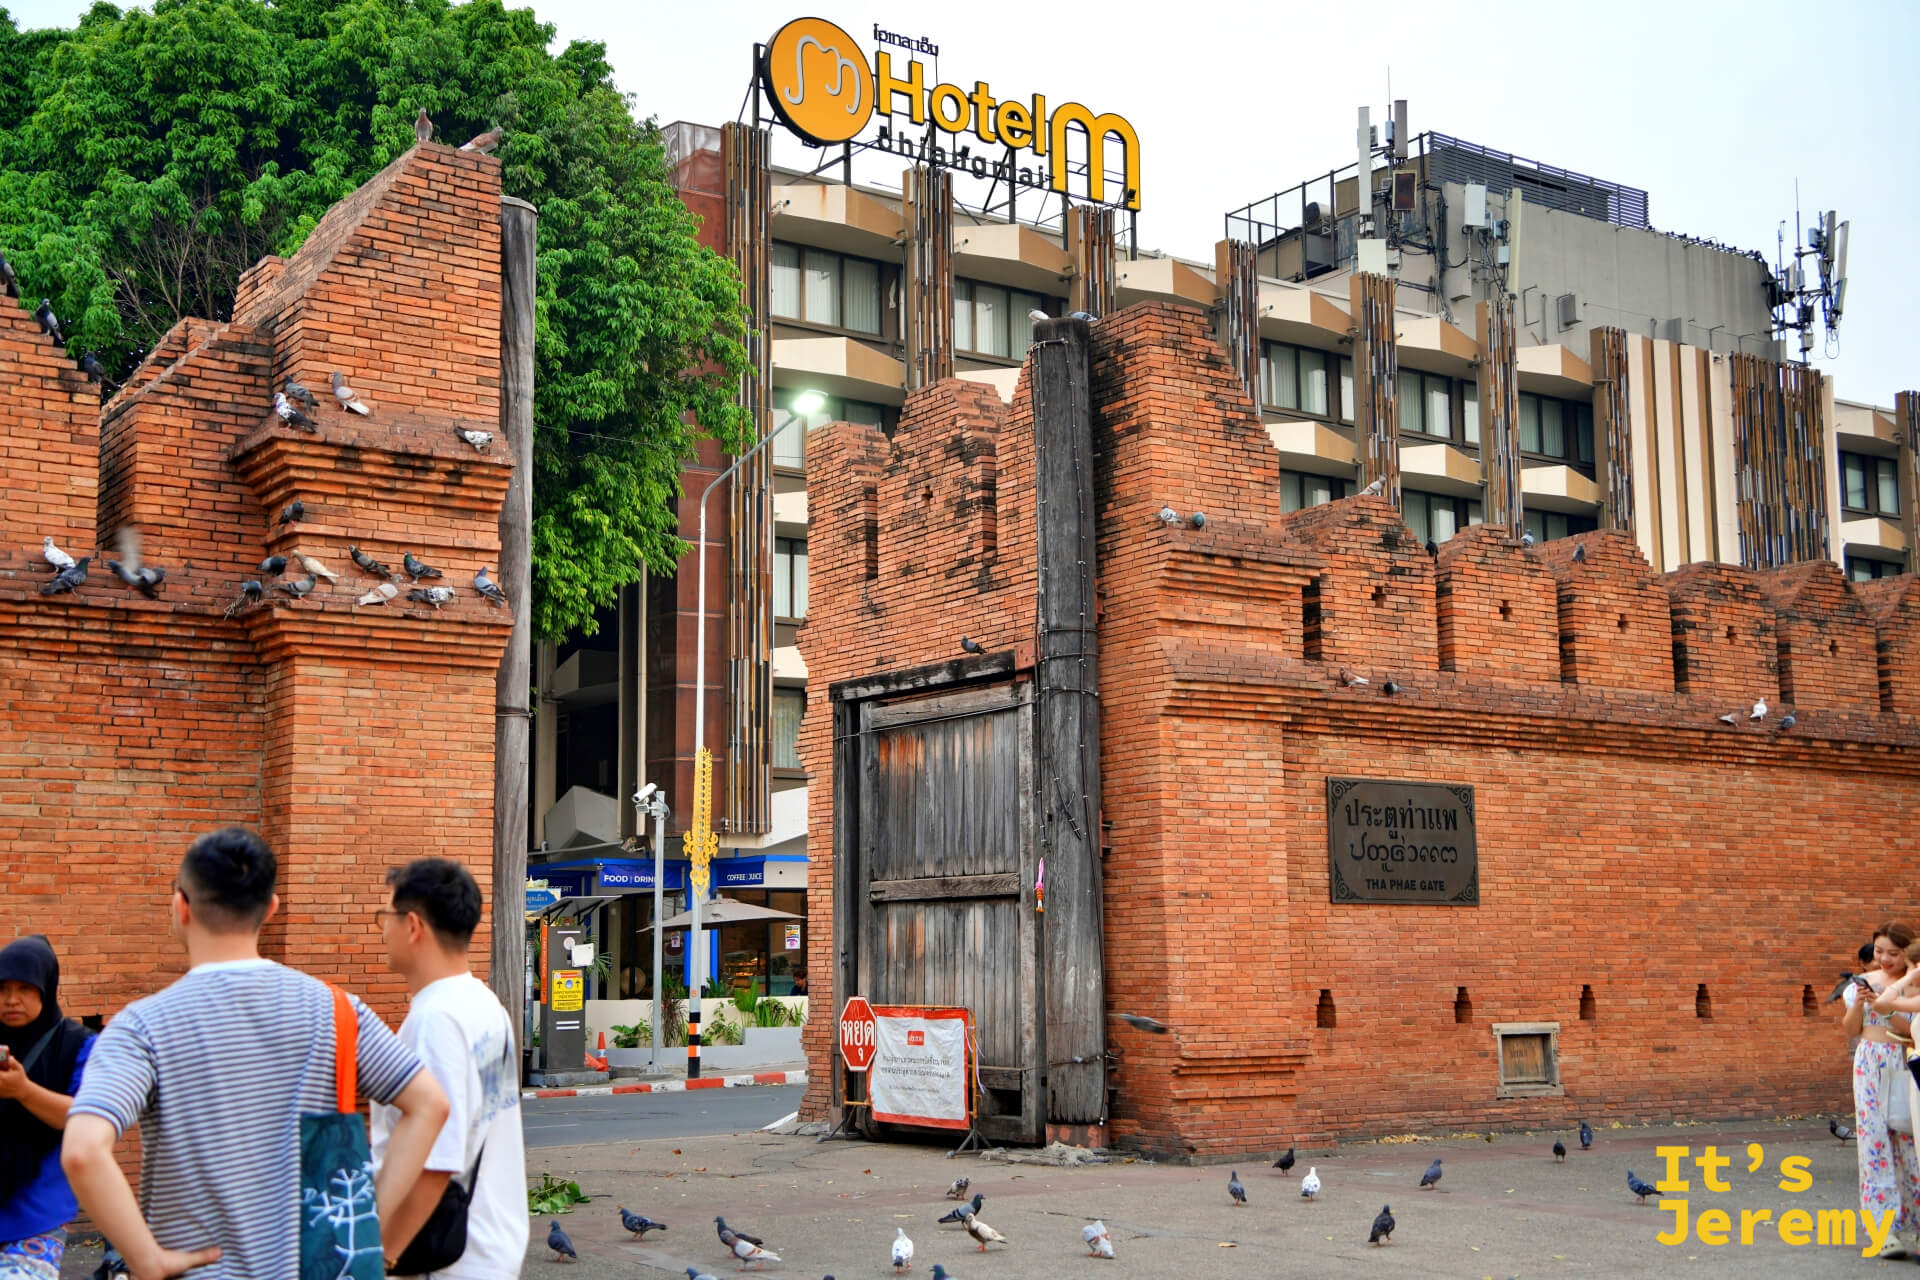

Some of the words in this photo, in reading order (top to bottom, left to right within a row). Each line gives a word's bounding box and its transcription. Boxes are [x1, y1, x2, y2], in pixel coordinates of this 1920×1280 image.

[1345, 798, 1458, 840] ประตูท่าแพ
[604, 874, 629, 883] FOOD
[634, 875, 656, 883] DRIN
[726, 873, 746, 881] COFFEE
[1366, 878, 1387, 890] THA
[1390, 879, 1417, 891] PHAE
[1420, 880, 1445, 892] GATE
[841, 1019, 875, 1063] หยุด
